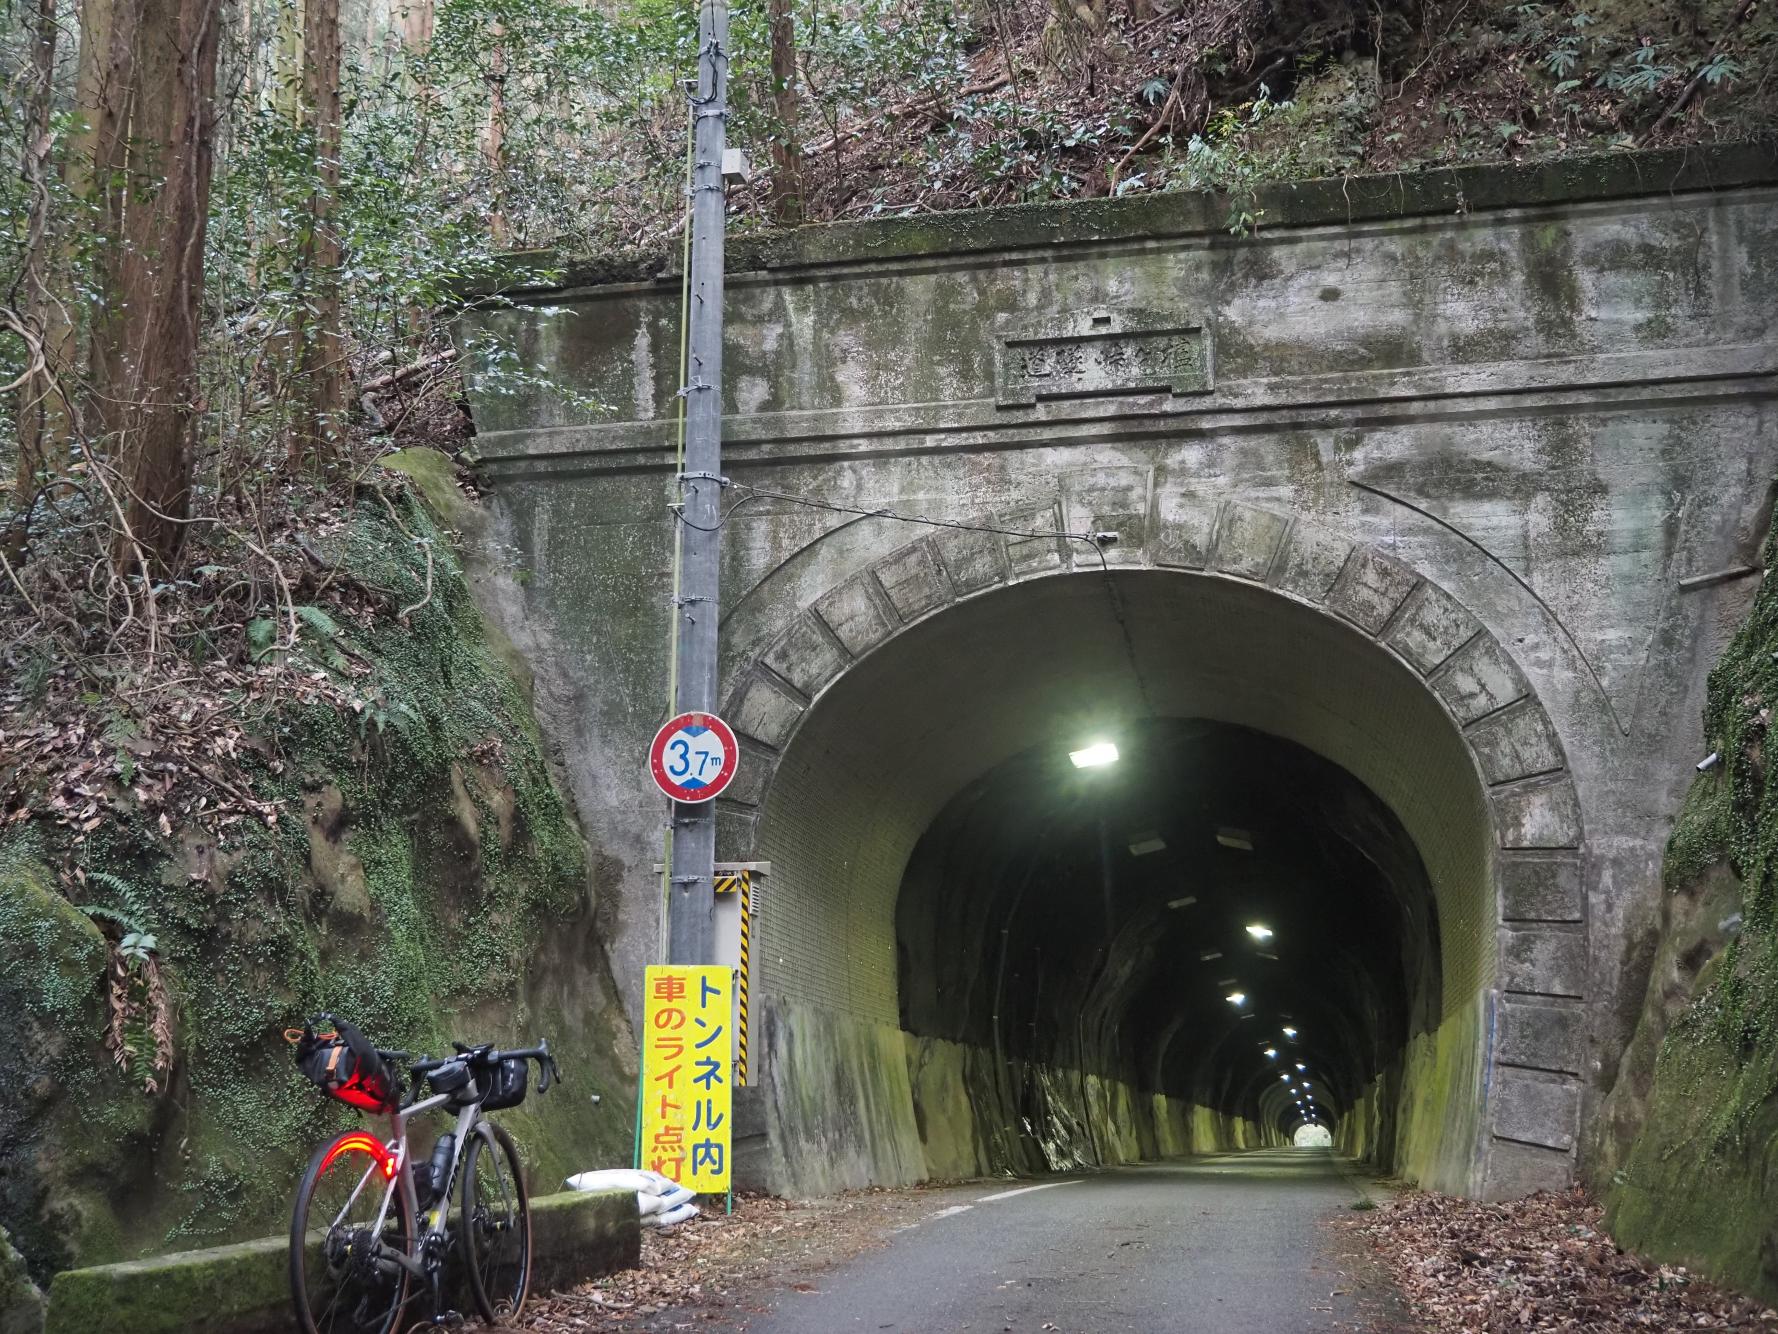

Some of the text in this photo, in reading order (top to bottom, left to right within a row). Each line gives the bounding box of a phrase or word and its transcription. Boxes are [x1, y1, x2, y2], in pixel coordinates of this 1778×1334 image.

[650, 975, 687, 1183] 車のライト点灯
[692, 975, 724, 1176] トンネル内
